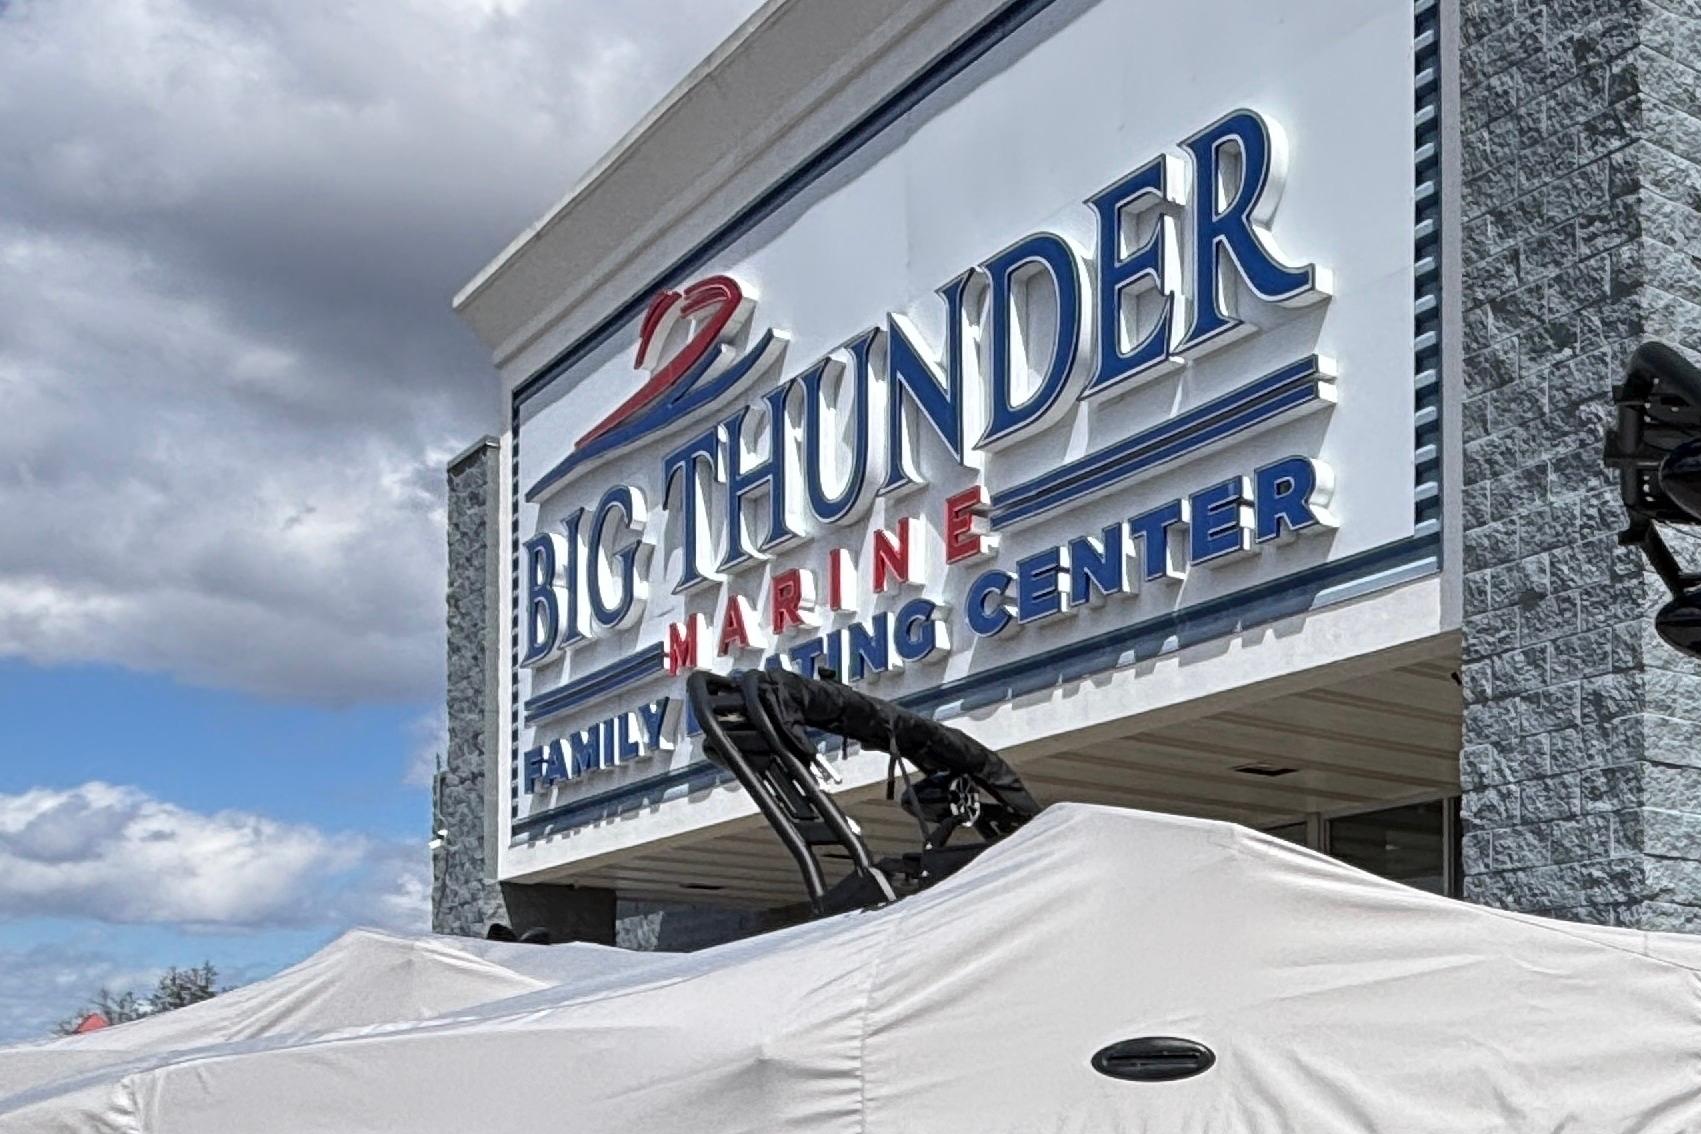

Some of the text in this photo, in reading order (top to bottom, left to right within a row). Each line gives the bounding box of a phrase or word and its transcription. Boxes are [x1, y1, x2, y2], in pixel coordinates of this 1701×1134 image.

[519, 108, 1320, 668] BIG THUNDER
[524, 455, 1320, 794] FAMILY TING CENTER
[668, 486, 988, 678] MARINE
